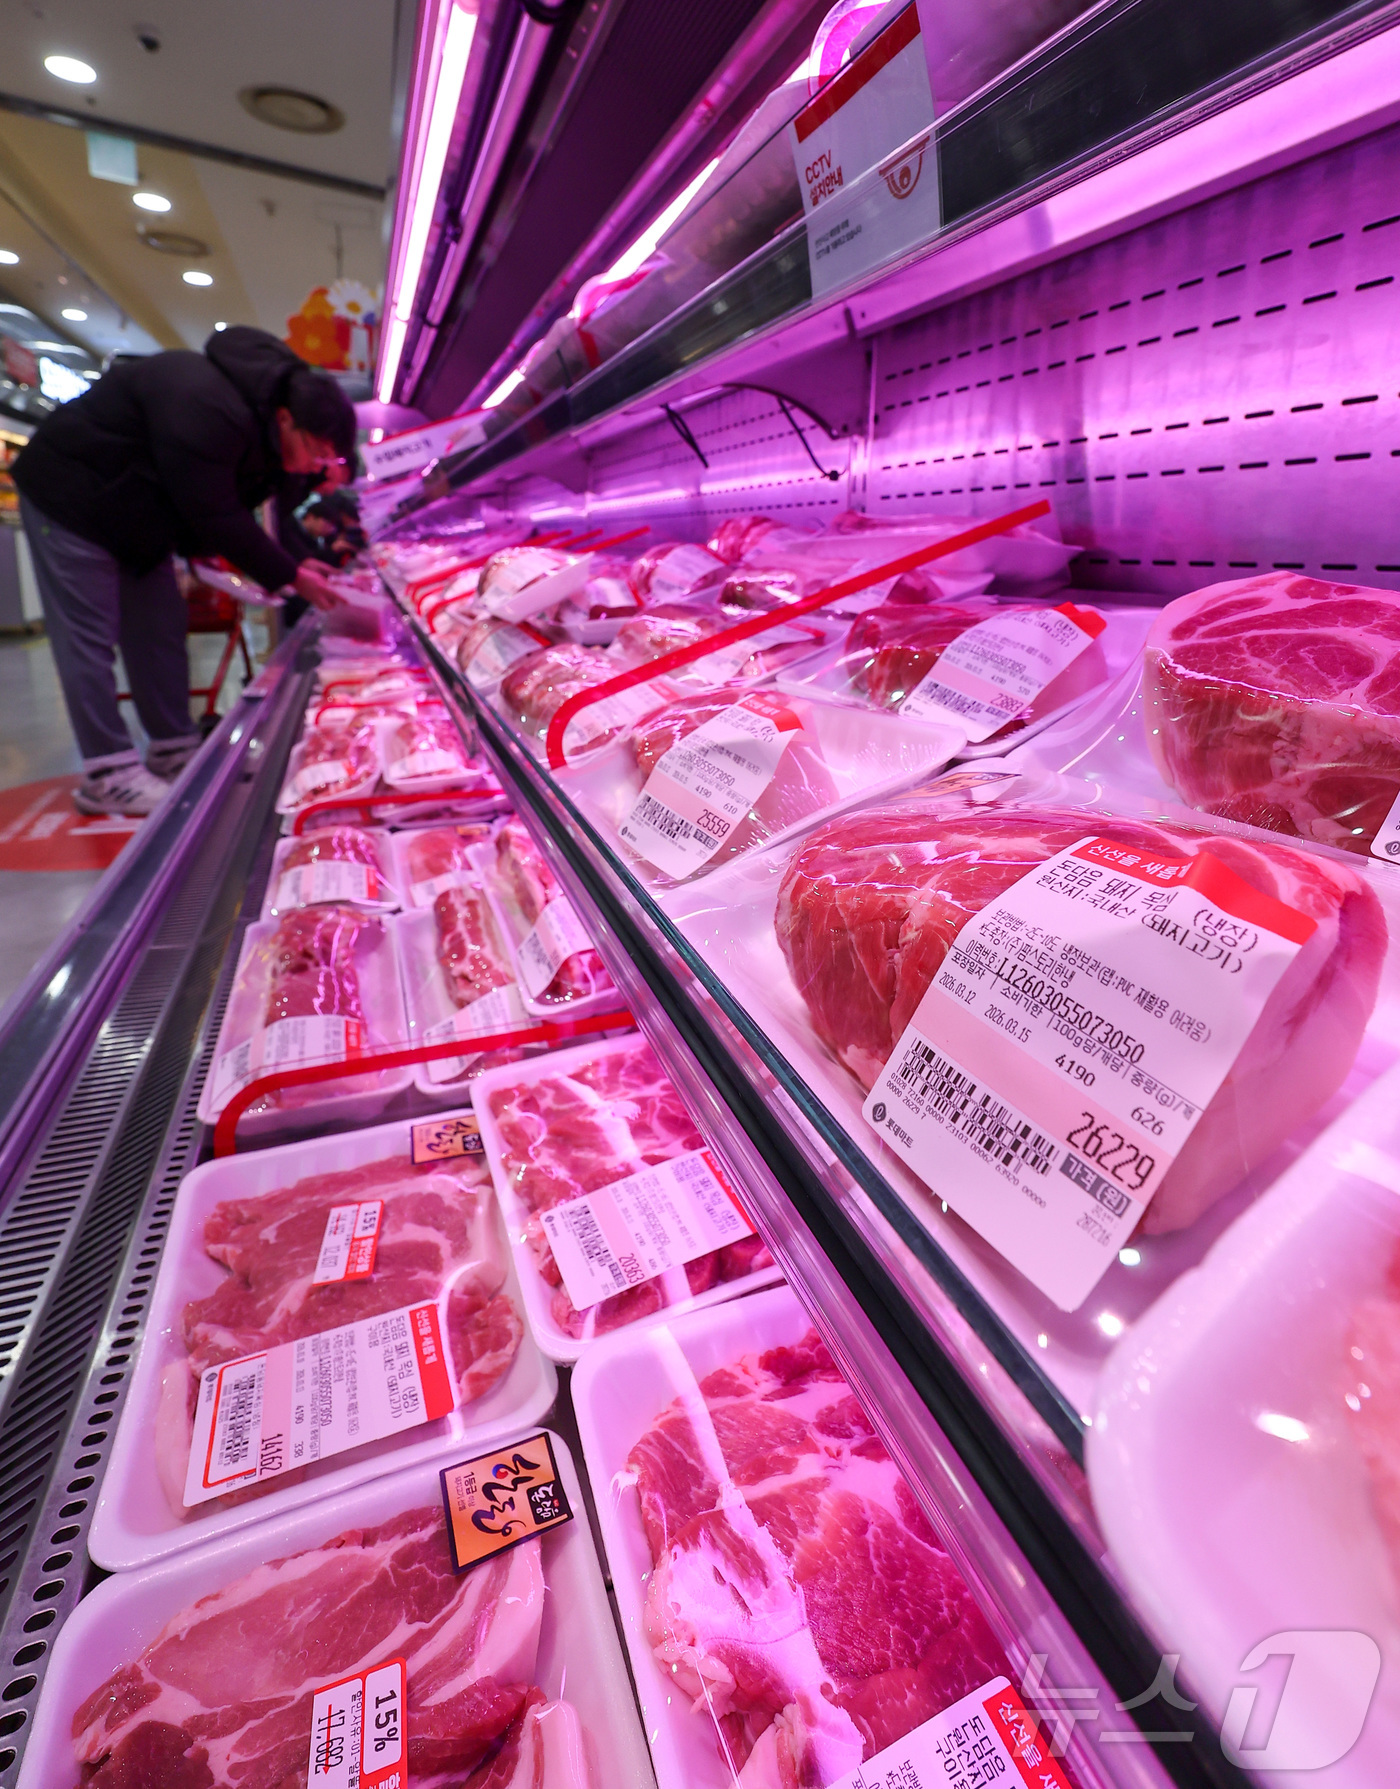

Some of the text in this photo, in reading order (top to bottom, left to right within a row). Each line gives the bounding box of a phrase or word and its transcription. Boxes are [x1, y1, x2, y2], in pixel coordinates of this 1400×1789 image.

[805, 149, 832, 184] CCTV
[810, 165, 843, 206] 설치안내
[695, 784, 738, 815] 4190 610
[696, 808, 731, 838] 25559
[1088, 844, 1140, 867] 신선을
[1036, 875, 1244, 974] 원산지:국내산 (돼지고기)
[1050, 860, 1259, 953] 돈담음 돼지 목심 (냉장)
[950, 952, 986, 980] 포장일자
[1000, 985, 1044, 1019] 소비기한
[1052, 1021, 1126, 1073] 100g당/개당
[1060, 943, 1137, 997] 냉장보관(랩:PVC
[1133, 988, 1170, 1019] 재활용
[1170, 1010, 1212, 1044] 어려움)
[938, 972, 1166, 1136] 2026.03.12 2026.03.15 4190 626
[886, 1080, 927, 1120] 00000 26229 7
[885, 1117, 914, 1148] 롯데마트
[925, 1102, 945, 1124] 00000
[945, 1123, 969, 1144] 23103
[970, 1142, 994, 1164] 00062
[1066, 1111, 1155, 1190] 26229
[1067, 1157, 1130, 1215] 가격 (원)
[362, 1210, 377, 1231] 15%
[618, 1253, 645, 1284] 20363
[389, 1315, 420, 1413] 돈담음 돼지 목심 (냉장)
[387, 1375, 402, 1418] (돼지고기)
[260, 1433, 283, 1476] 14162
[294, 1405, 304, 1459] 4190 338
[464, 1471, 477, 1494] 1등급
[471, 1453, 541, 1537] 한돈
[314, 1709, 346, 1775] 17,682
[348, 1690, 363, 1789] 할인사유:01-알뜰
[374, 1690, 399, 1752] 15%
[962, 1715, 1006, 1782] 돈담음
[998, 1702, 1042, 1768] 신선을
